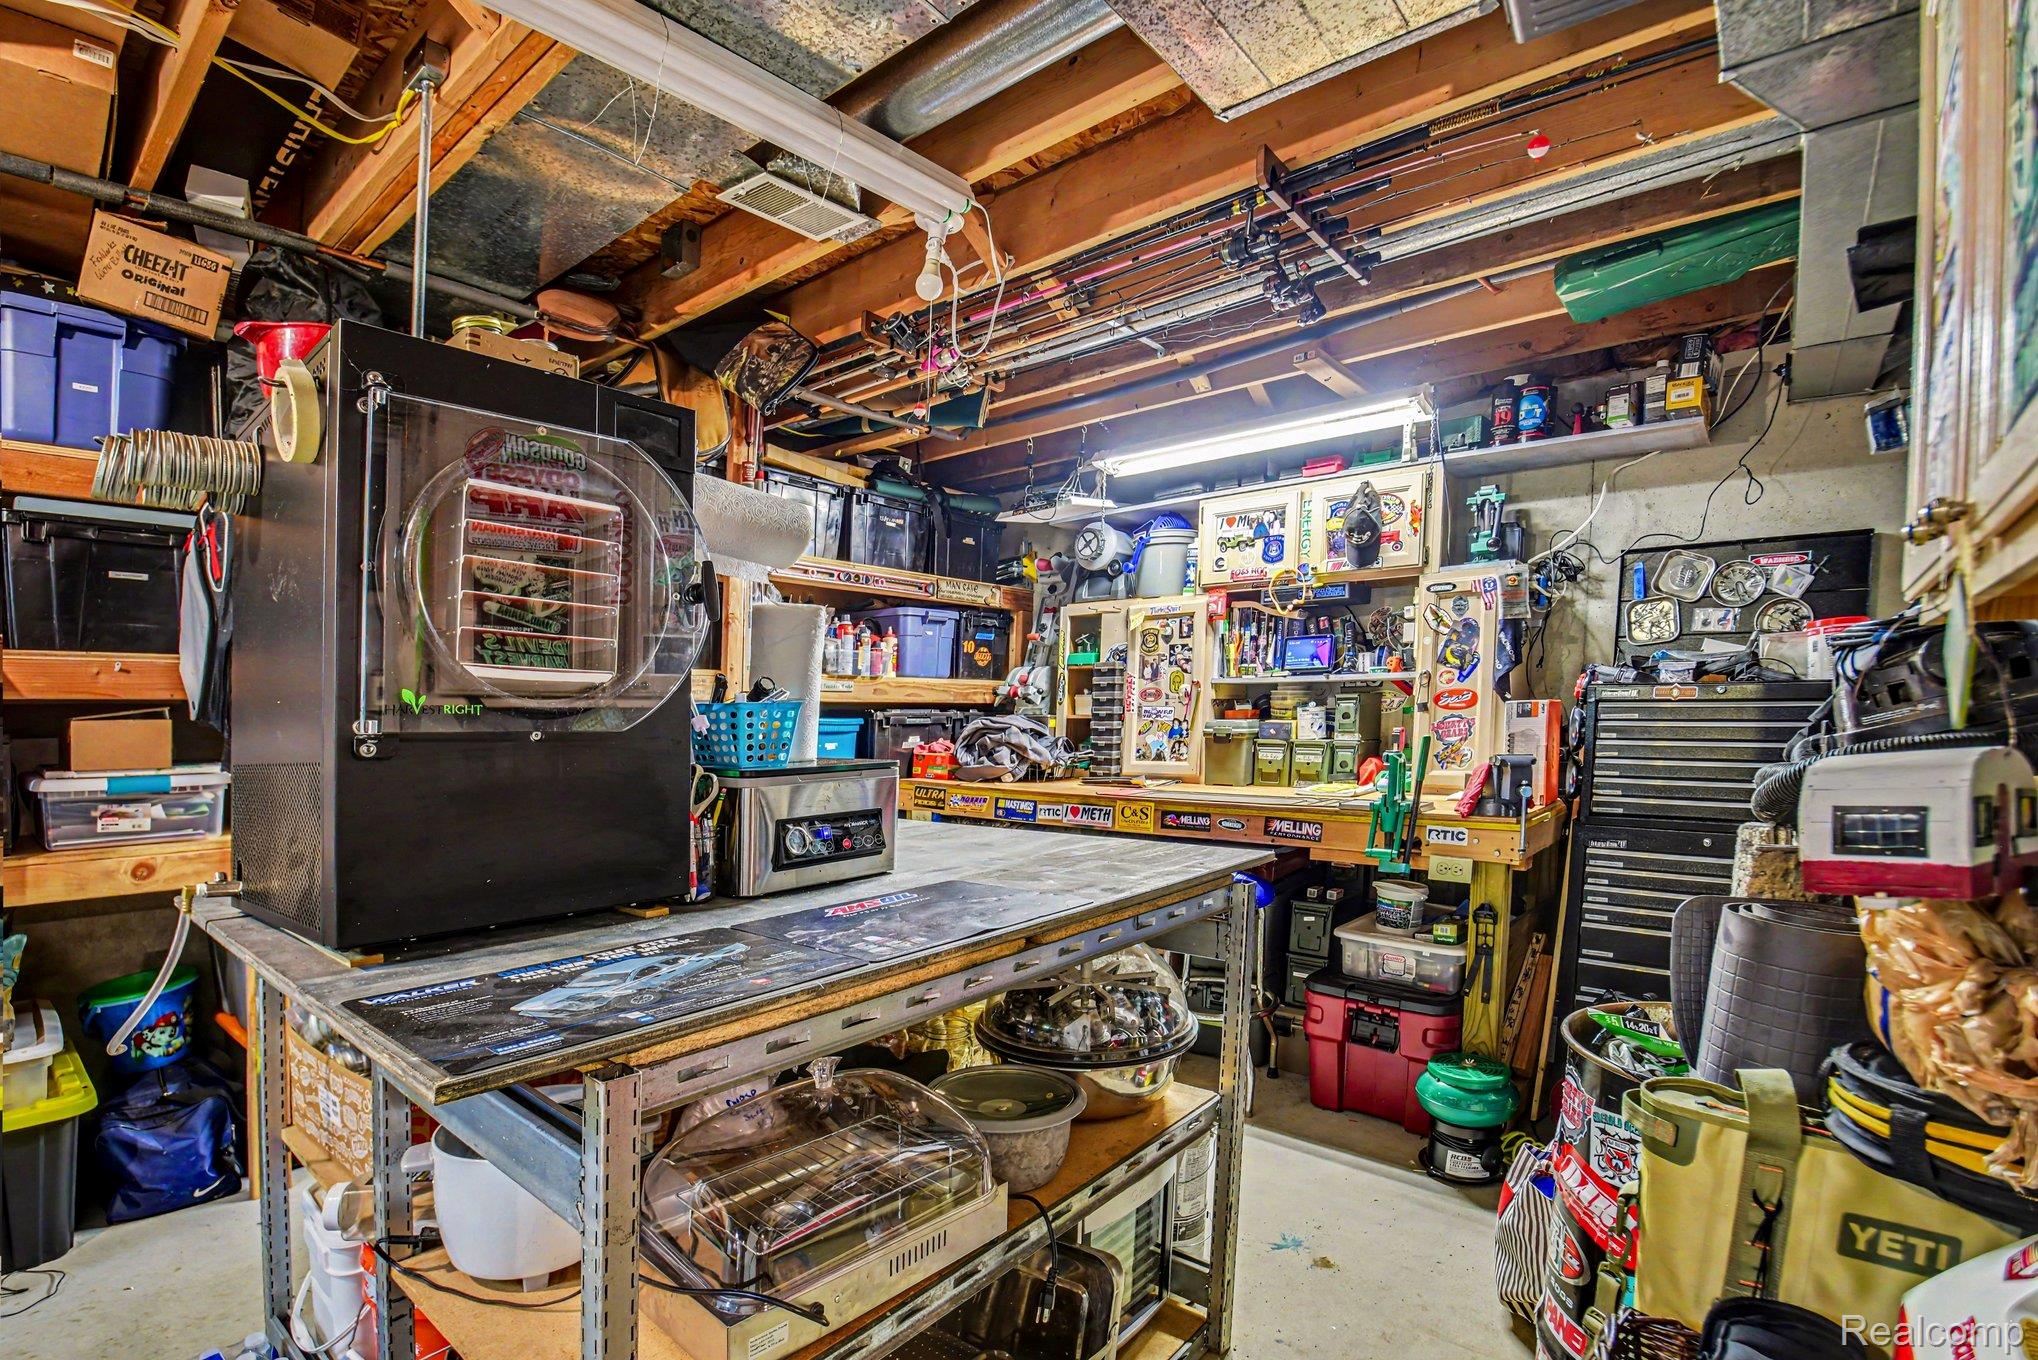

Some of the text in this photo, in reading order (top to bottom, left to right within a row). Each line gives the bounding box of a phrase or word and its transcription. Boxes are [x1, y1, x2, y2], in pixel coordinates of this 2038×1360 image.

[1301, 499, 1313, 558] ENERGY
[963, 640, 975, 654] 10
[915, 787, 946, 800] ULTRA
[1006, 798, 1034, 811] HASTINGS
[1039, 808, 1061, 817] RTIC
[1064, 805, 1111, 822] I METH
[1120, 806, 1150, 821] C&S
[1179, 815, 1211, 826] MELLING
[1270, 818, 1321, 837] MELLING
[1427, 829, 1467, 843] RTIC
[824, 891, 919, 918] AMSOIL
[1848, 1222, 1950, 1271] YETI
